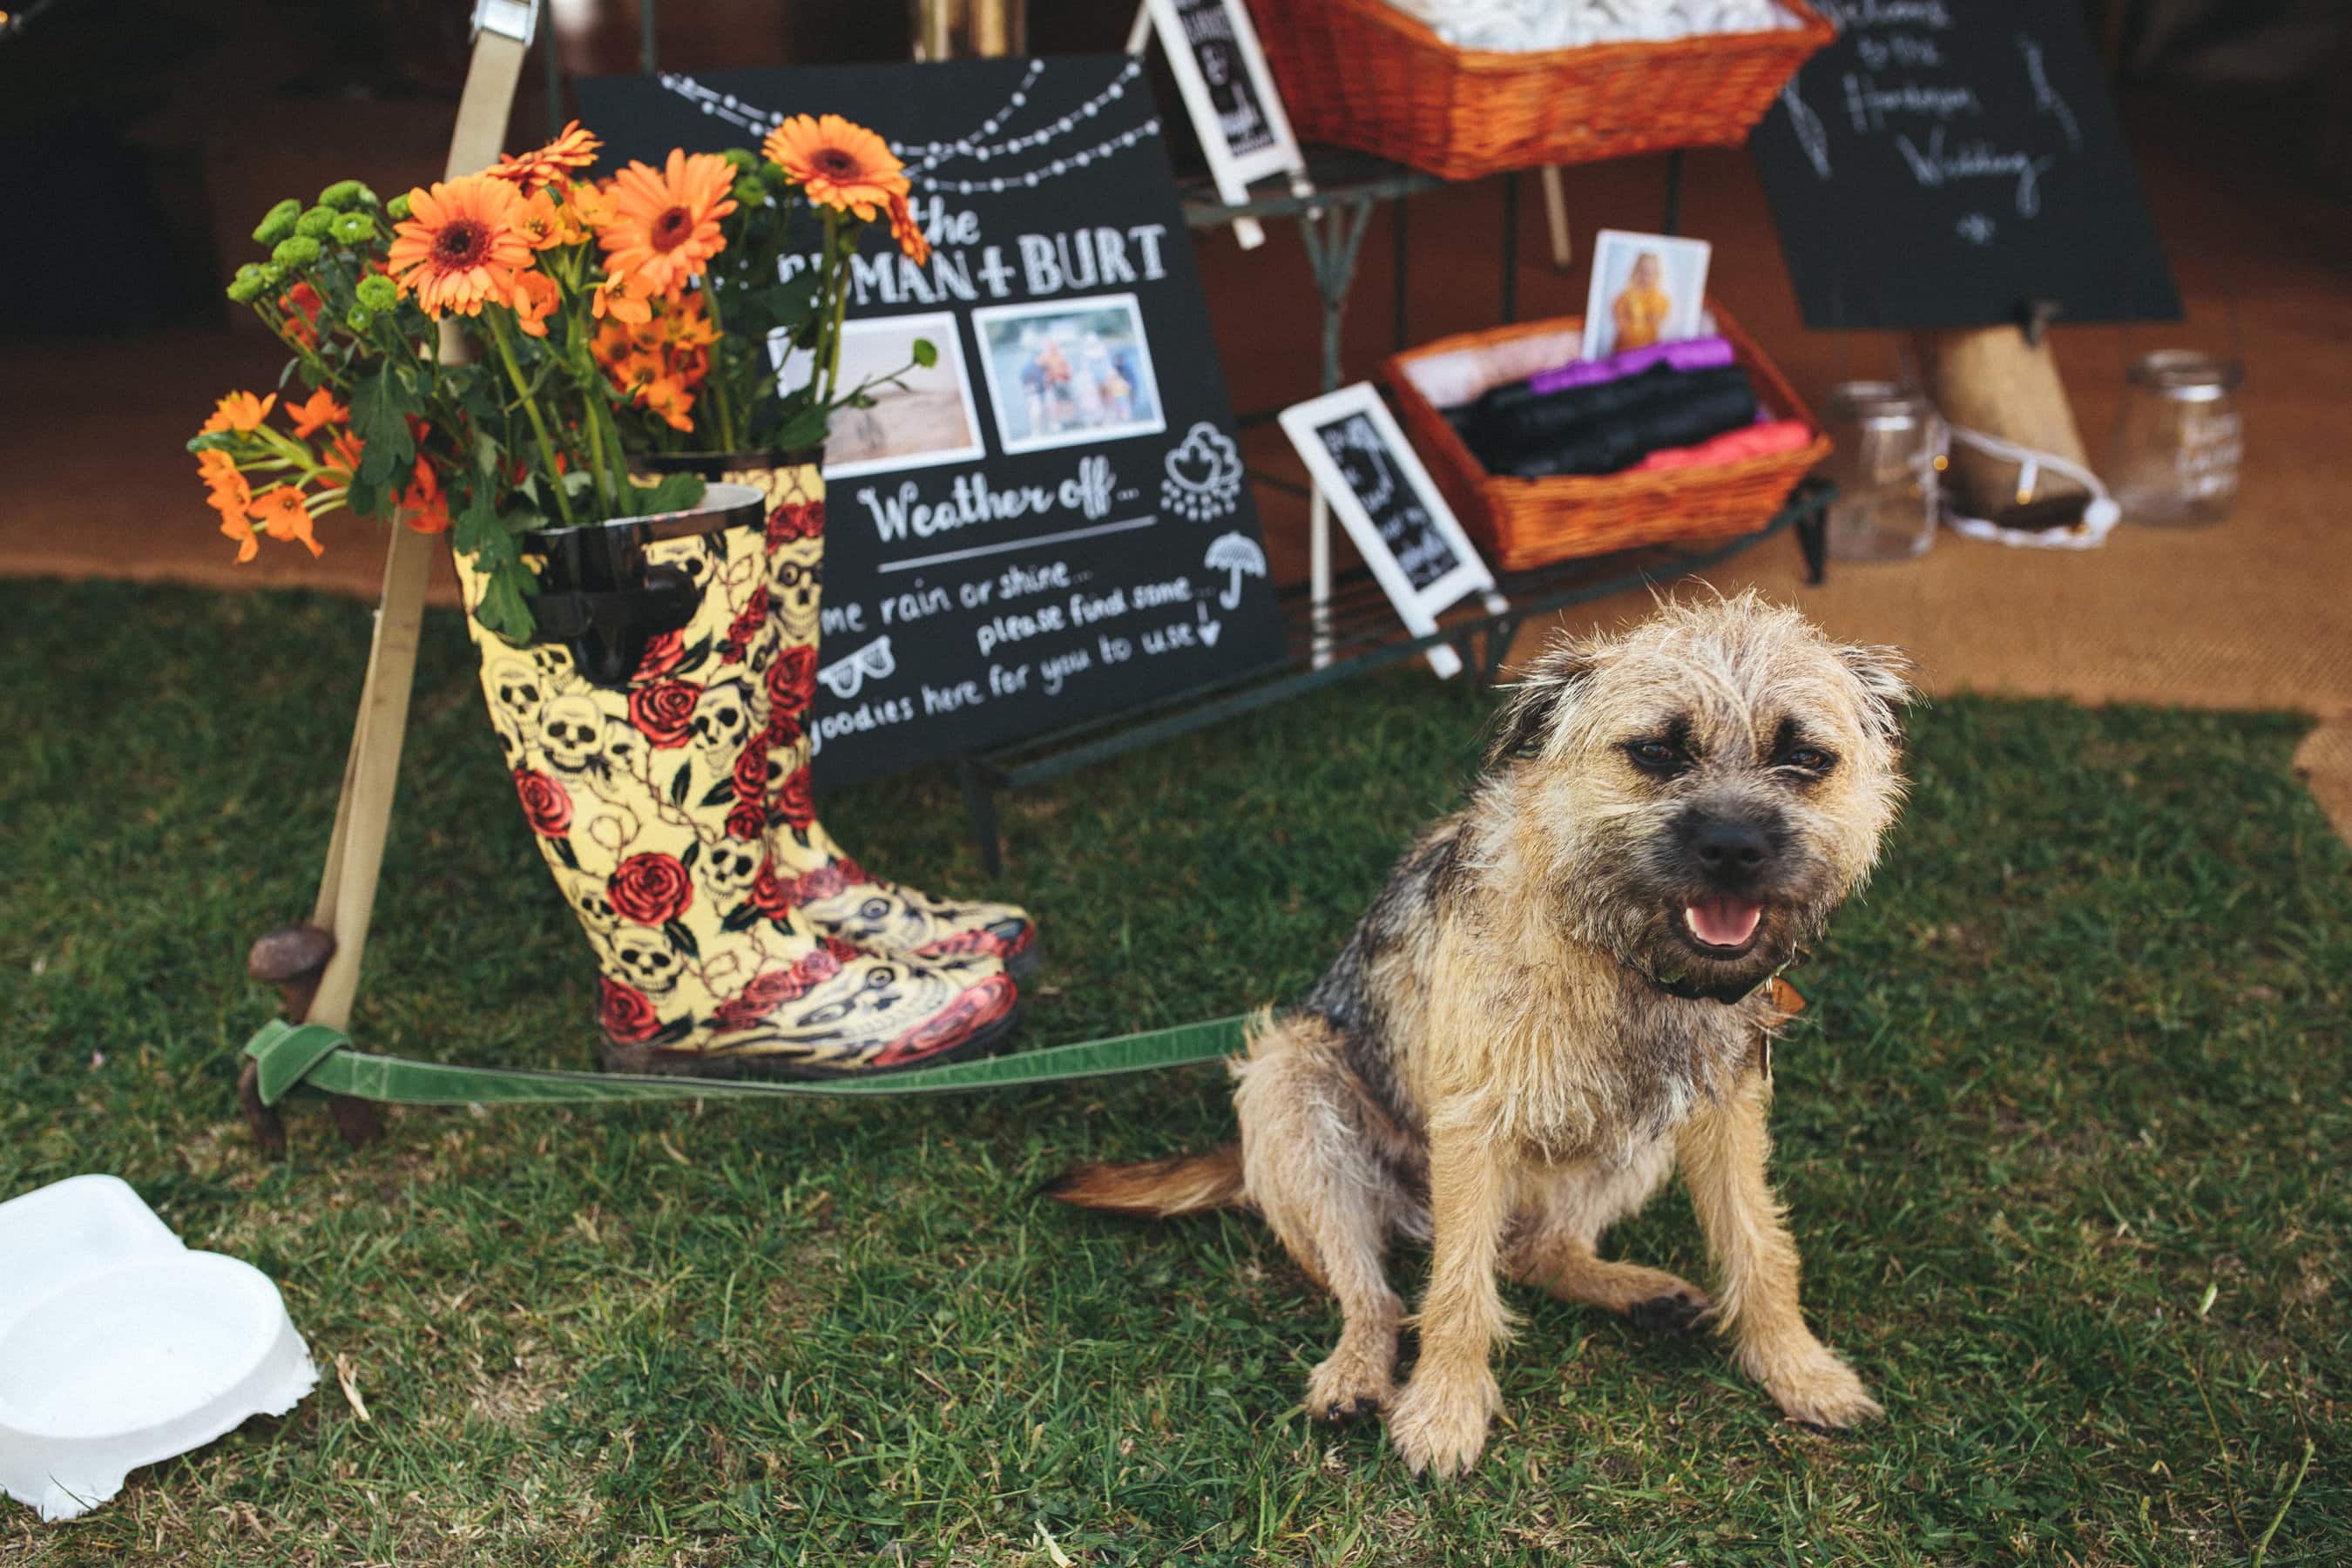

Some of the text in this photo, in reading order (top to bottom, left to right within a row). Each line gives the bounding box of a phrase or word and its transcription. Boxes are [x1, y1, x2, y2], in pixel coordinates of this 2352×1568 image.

[1017, 223, 1166, 296] BURT
[856, 471, 1055, 543] Weather
[880, 578, 953, 625] rain
[959, 578, 993, 609] or
[977, 605, 1066, 657] please
[1069, 586, 1128, 627] find
[920, 679, 986, 716] here
[989, 663, 1031, 696] for
[1039, 648, 1092, 695] you
[1098, 633, 1132, 665] to
